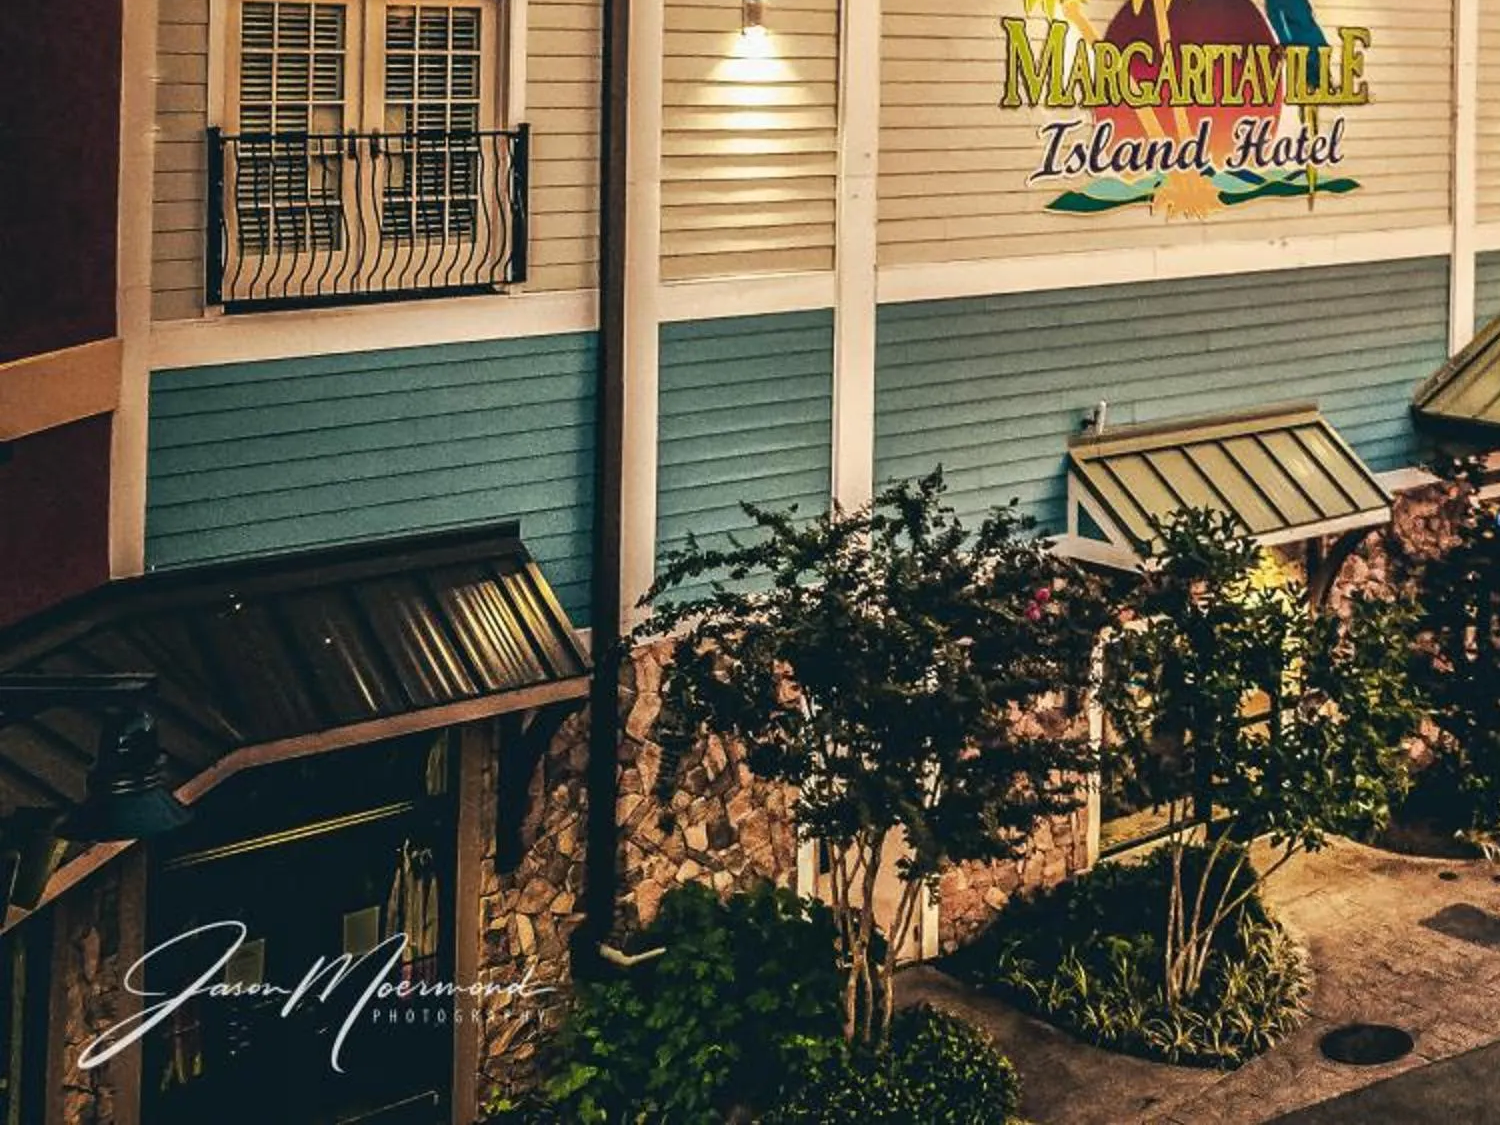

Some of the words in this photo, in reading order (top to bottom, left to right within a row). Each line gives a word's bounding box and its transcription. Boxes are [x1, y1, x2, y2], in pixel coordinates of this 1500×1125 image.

[1001, 17, 1371, 107] MARGARITAVILLE
[1030, 119, 1210, 184] Island
[1226, 117, 1345, 169] Hotel
